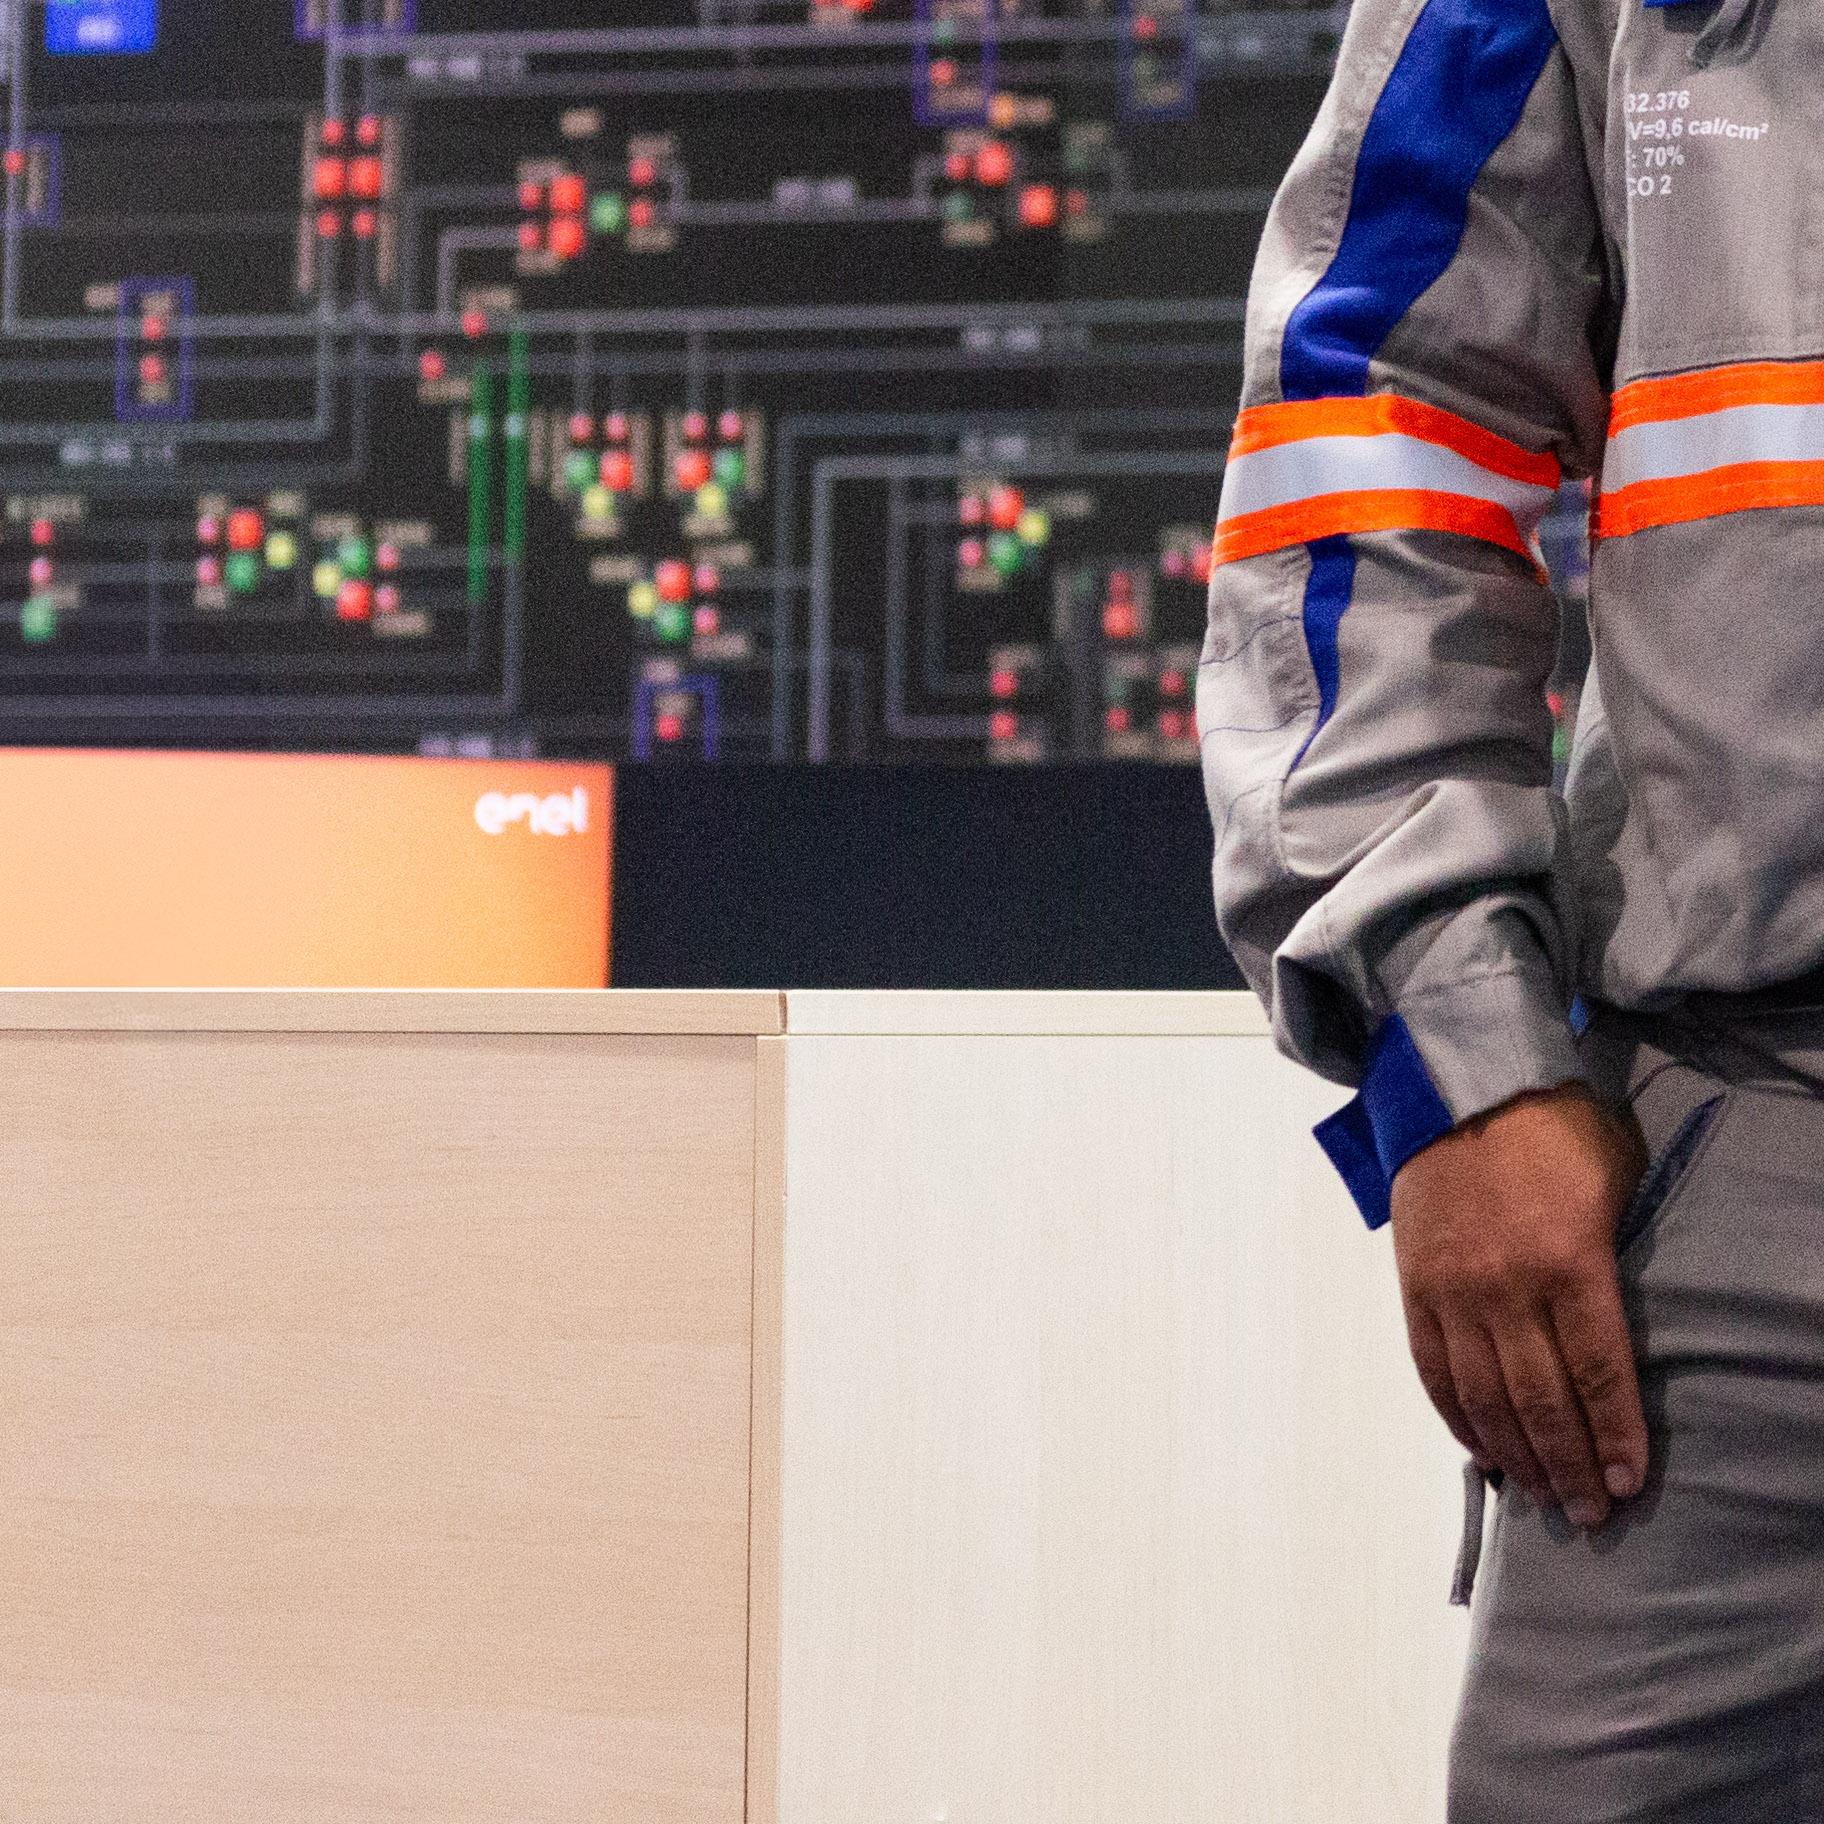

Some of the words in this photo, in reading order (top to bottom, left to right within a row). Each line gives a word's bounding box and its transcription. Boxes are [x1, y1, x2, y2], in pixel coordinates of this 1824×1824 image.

[1688, 117, 1770, 141] cal/cm²
[1643, 144, 1686, 169] 70%
[1660, 173, 1673, 196] 2
[474, 784, 589, 836] enel
